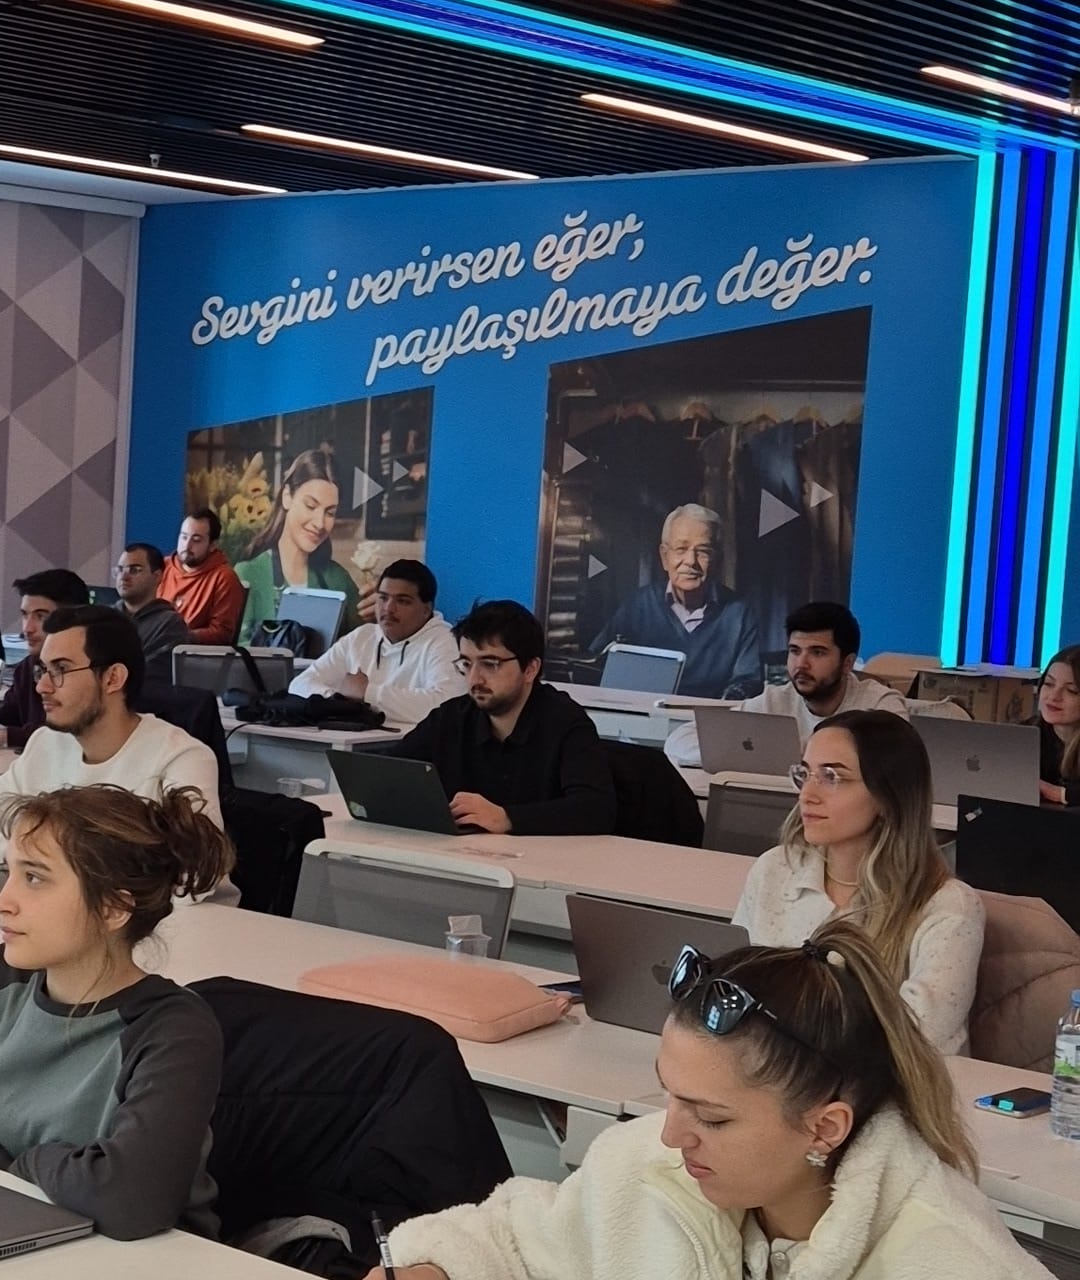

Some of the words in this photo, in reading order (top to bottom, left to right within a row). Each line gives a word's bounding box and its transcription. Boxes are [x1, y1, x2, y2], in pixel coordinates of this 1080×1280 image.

[191, 268, 338, 345] Sevgini
[346, 241, 526, 310] verirsen
[532, 209, 644, 282] eğer,
[365, 275, 707, 386] paylaşılmaya
[716, 233, 878, 310] değer.
